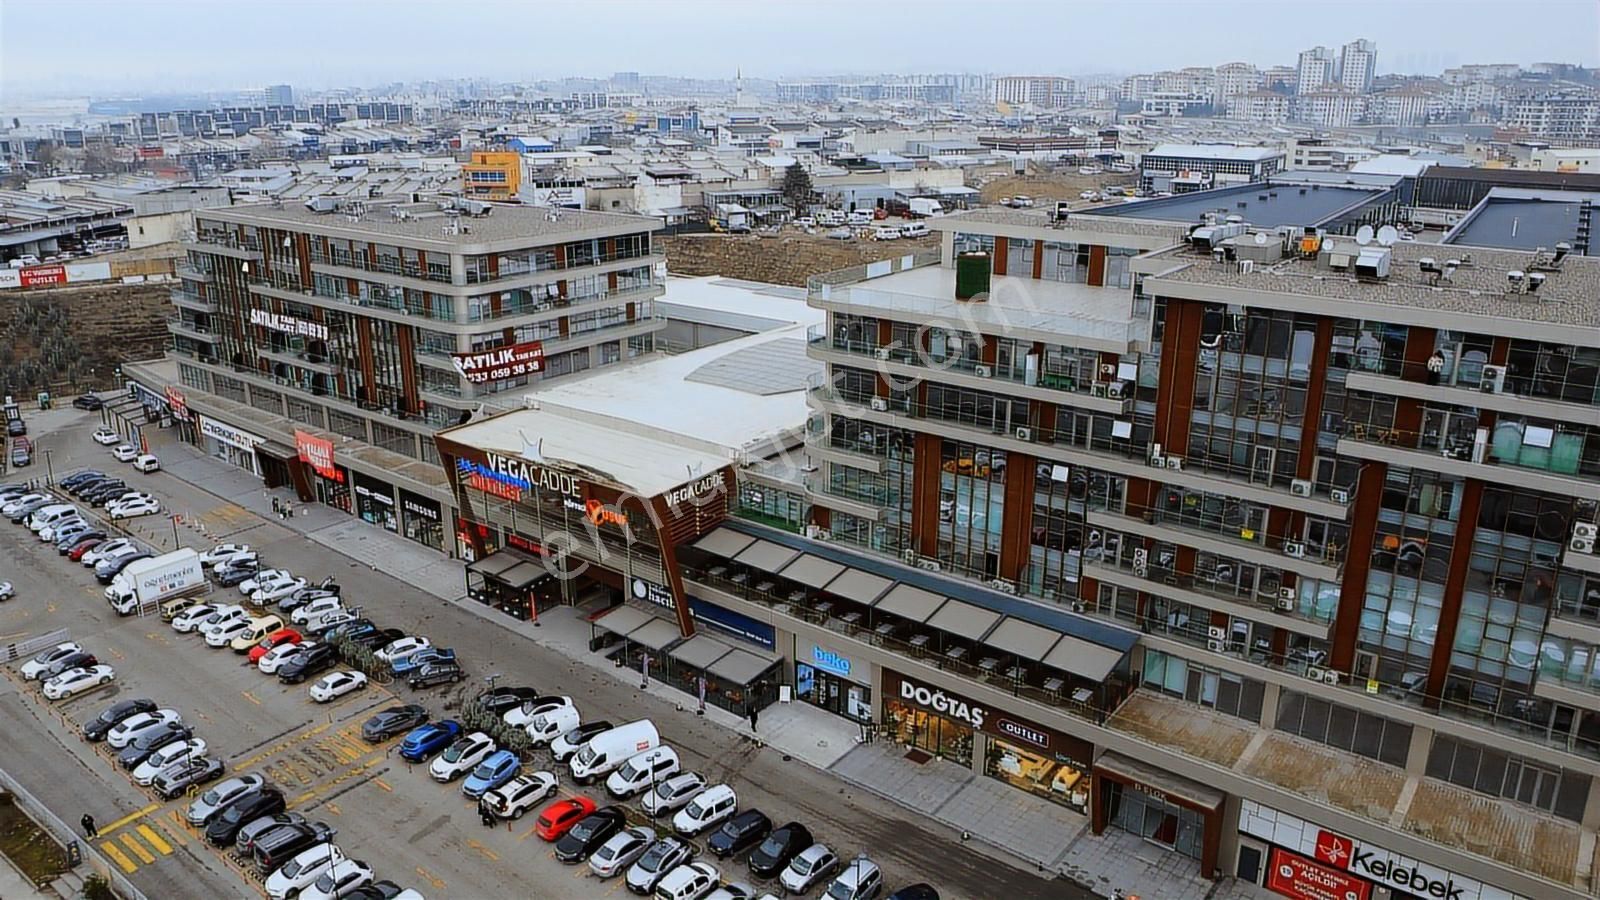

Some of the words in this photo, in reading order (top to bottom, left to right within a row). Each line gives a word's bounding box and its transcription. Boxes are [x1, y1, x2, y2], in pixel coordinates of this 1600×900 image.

[28, 276, 58, 284] OUTLET
[251, 308, 280, 330] SATILIK
[452, 348, 516, 370] SATILIK
[491, 368, 511, 379] 059
[512, 363, 526, 375] 38
[527, 361, 540, 372] 38
[486, 452, 582, 498] VEGACADDE
[664, 471, 725, 507] VEGACADDE
[814, 645, 851, 672] beko
[901, 680, 984, 730] DOĞTAŞ
[1005, 723, 1045, 744] OUTLET
[1351, 847, 1464, 900] Kelebek
